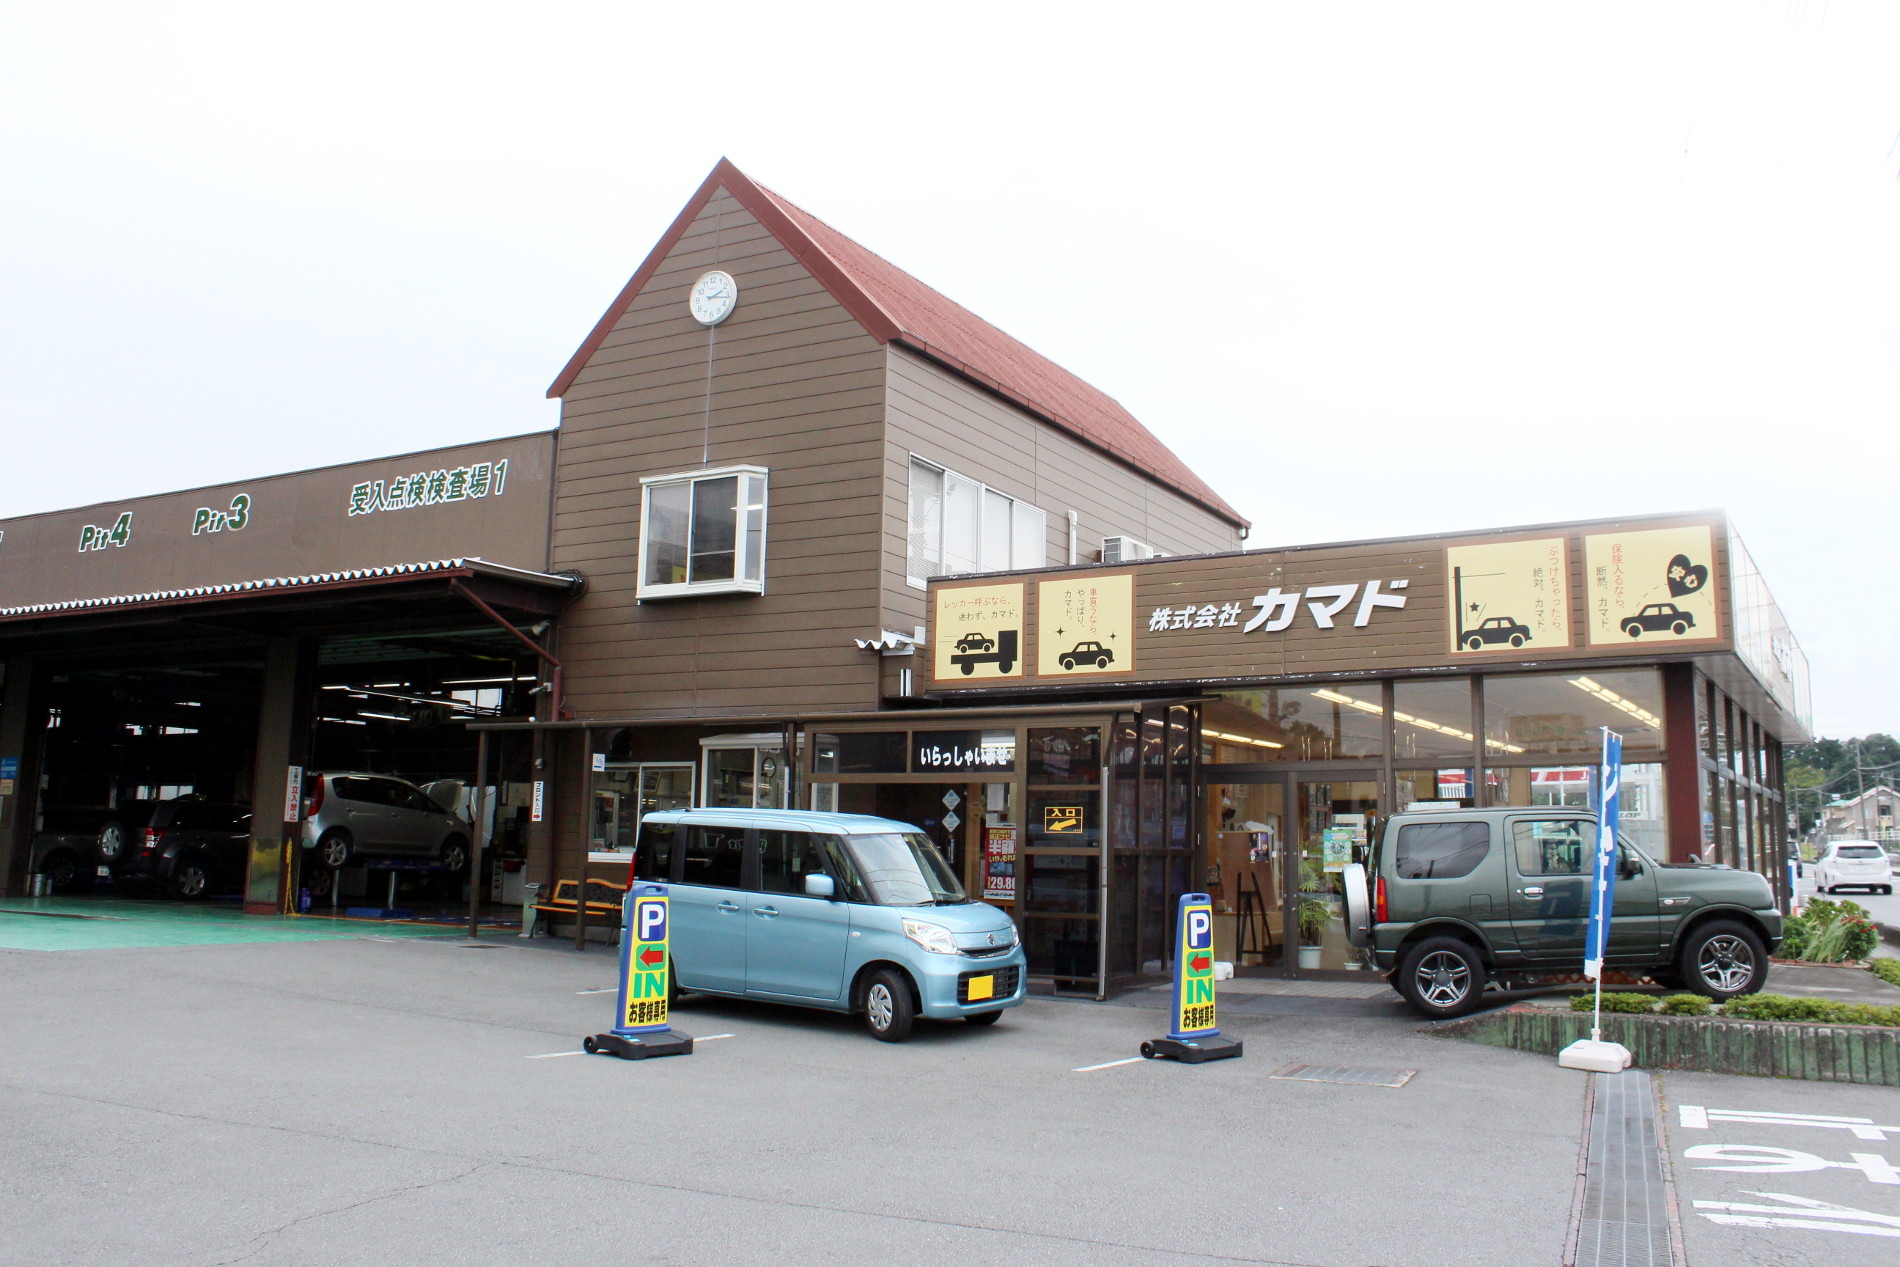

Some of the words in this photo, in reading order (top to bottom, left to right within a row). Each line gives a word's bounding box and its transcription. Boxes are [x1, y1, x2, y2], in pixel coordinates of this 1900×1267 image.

[1549, 545, 1562, 632] ぶつけちゃったら、
[1612, 543, 1625, 610] 保険入るなら、
[1668, 565, 1699, 589] 安心
[944, 595, 1011, 609] レッカー呼ぶなら、
[958, 608, 1019, 622] 迷わず、カマド。
[1064, 589, 1074, 620] カマド。
[1076, 588, 1086, 628] やっぱり、
[1089, 587, 1098, 636] 車買うなら、
[1149, 602, 1242, 632] 株式会社
[1243, 579, 1410, 634] カマド
[1533, 567, 1547, 633] 絶対、カマド。
[1596, 566, 1610, 632] 断然、カマド。
[920, 745, 1011, 766] いらっしゃいませ
[289, 785, 300, 821] 立入禁止
[1051, 808, 1076, 817] 入口
[641, 904, 665, 939] P
[1190, 912, 1210, 947] P
[633, 971, 666, 999] IN
[1186, 978, 1213, 1005] IN
[628, 999, 667, 1024] お客様専用
[1183, 1004, 1214, 1028] お客様専用
